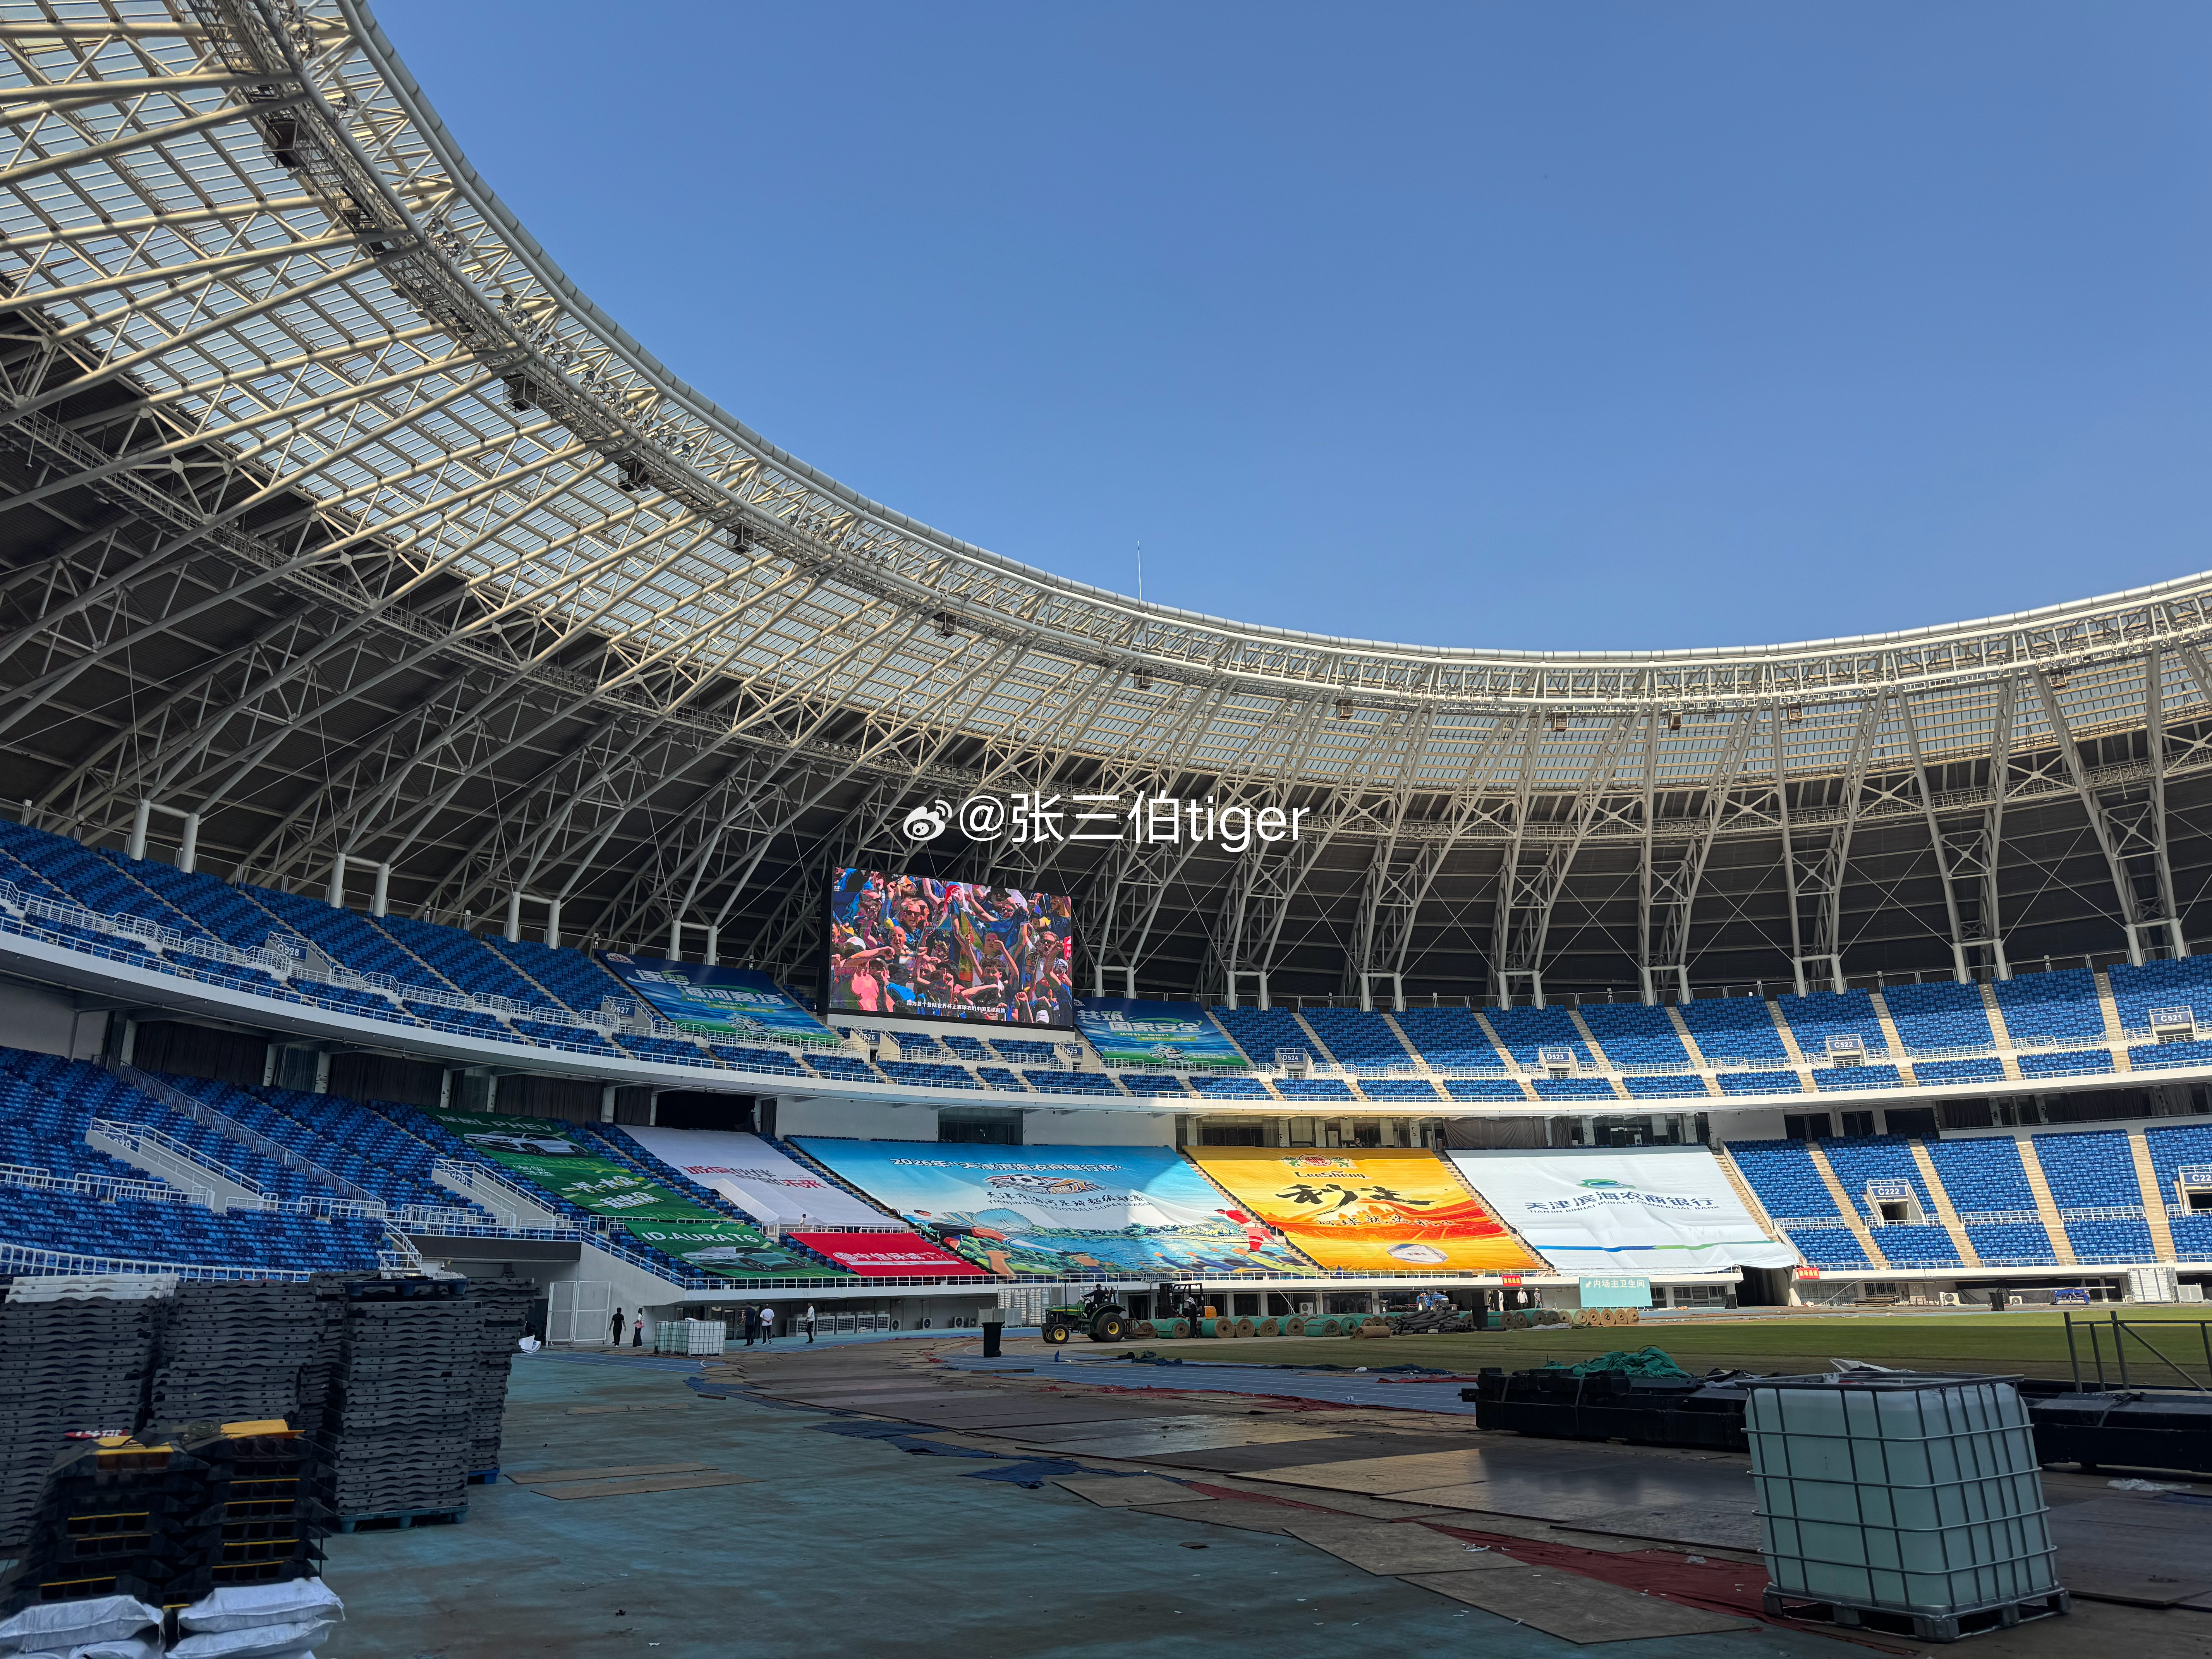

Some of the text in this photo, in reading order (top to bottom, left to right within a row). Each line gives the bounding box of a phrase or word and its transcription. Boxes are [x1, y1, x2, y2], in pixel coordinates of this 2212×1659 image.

[676, 985, 785, 1006] 海河赛场
[1077, 1010, 1125, 1022] 共筑
[1109, 1021, 1202, 1032] 国家安全
[491, 1121, 552, 1131] PHEV
[680, 1166, 776, 1178] 诚信伙伴
[1275, 1183, 1435, 1216] 利生
[1525, 1191, 1714, 1210] 天津滨海农商银行
[1565, 1204, 1595, 1212] BINHAI
[1631, 1200, 1693, 1210] COMMERCIAL
[1594, 1279, 1645, 1288] 内场主卫生间
